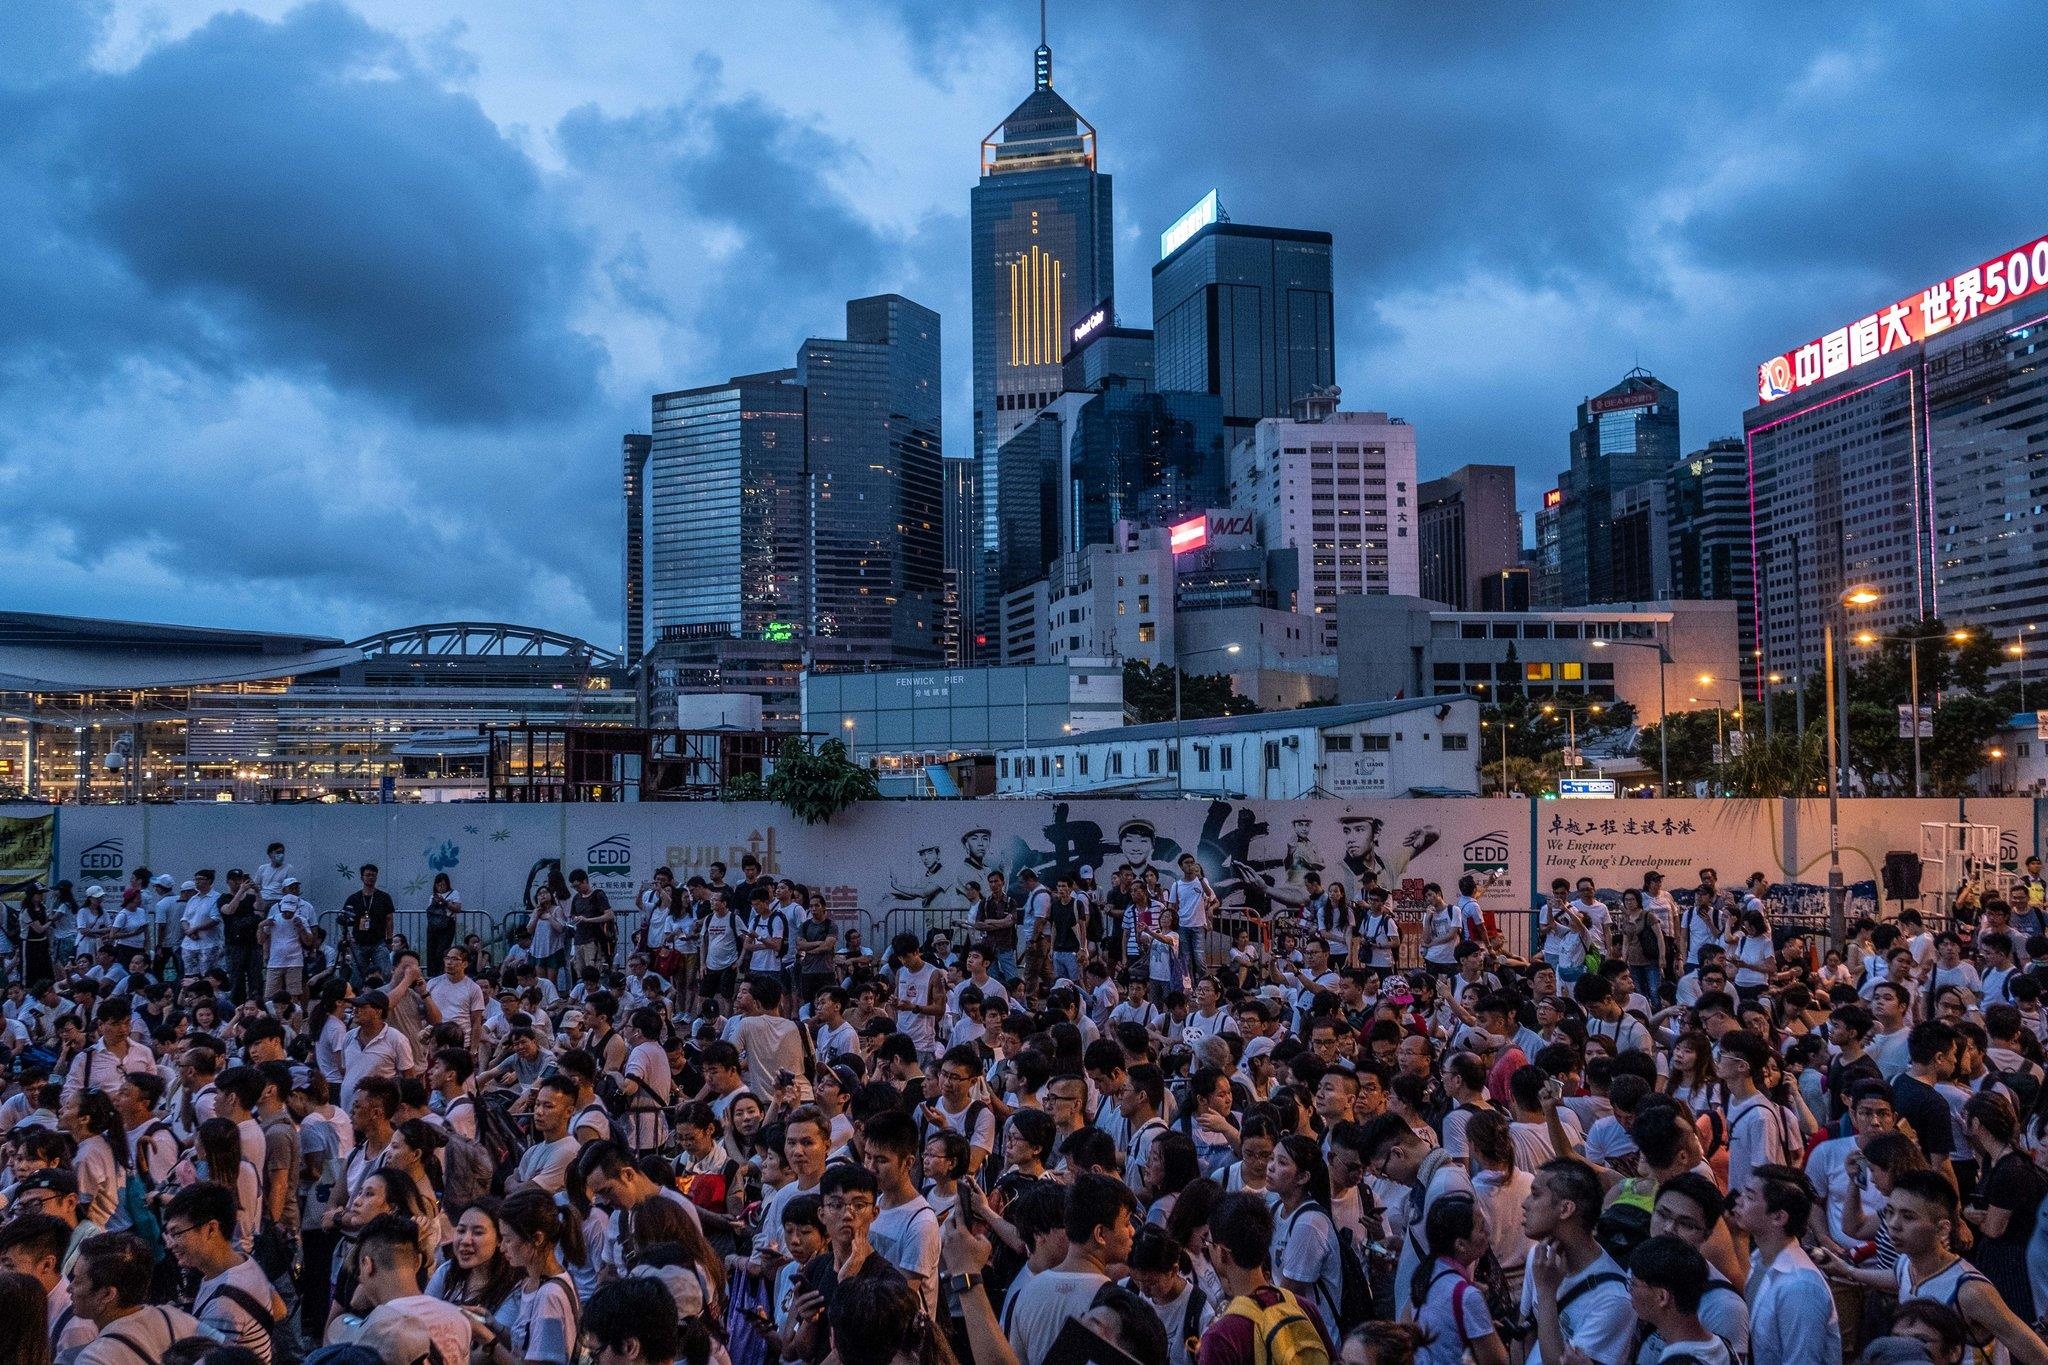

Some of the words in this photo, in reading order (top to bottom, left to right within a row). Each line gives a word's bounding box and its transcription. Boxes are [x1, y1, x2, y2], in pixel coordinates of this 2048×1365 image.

[896, 677, 935, 686] FENWICK
[944, 675, 964, 684] PIER
[1548, 813, 1618, 836] 卓越工程
[1622, 817, 1696, 836] 建設香港
[1546, 839, 1563, 851] We
[1567, 839, 1616, 854] Engineer
[1999, 846, 2018, 861] DD
[80, 854, 123, 868] CEDD
[588, 850, 631, 864] CEDD
[1463, 847, 1508, 861] CEDD
[1545, 855, 1578, 869] Hong
[1580, 854, 1617, 869] Kong's
[1619, 855, 1692, 870] Development
